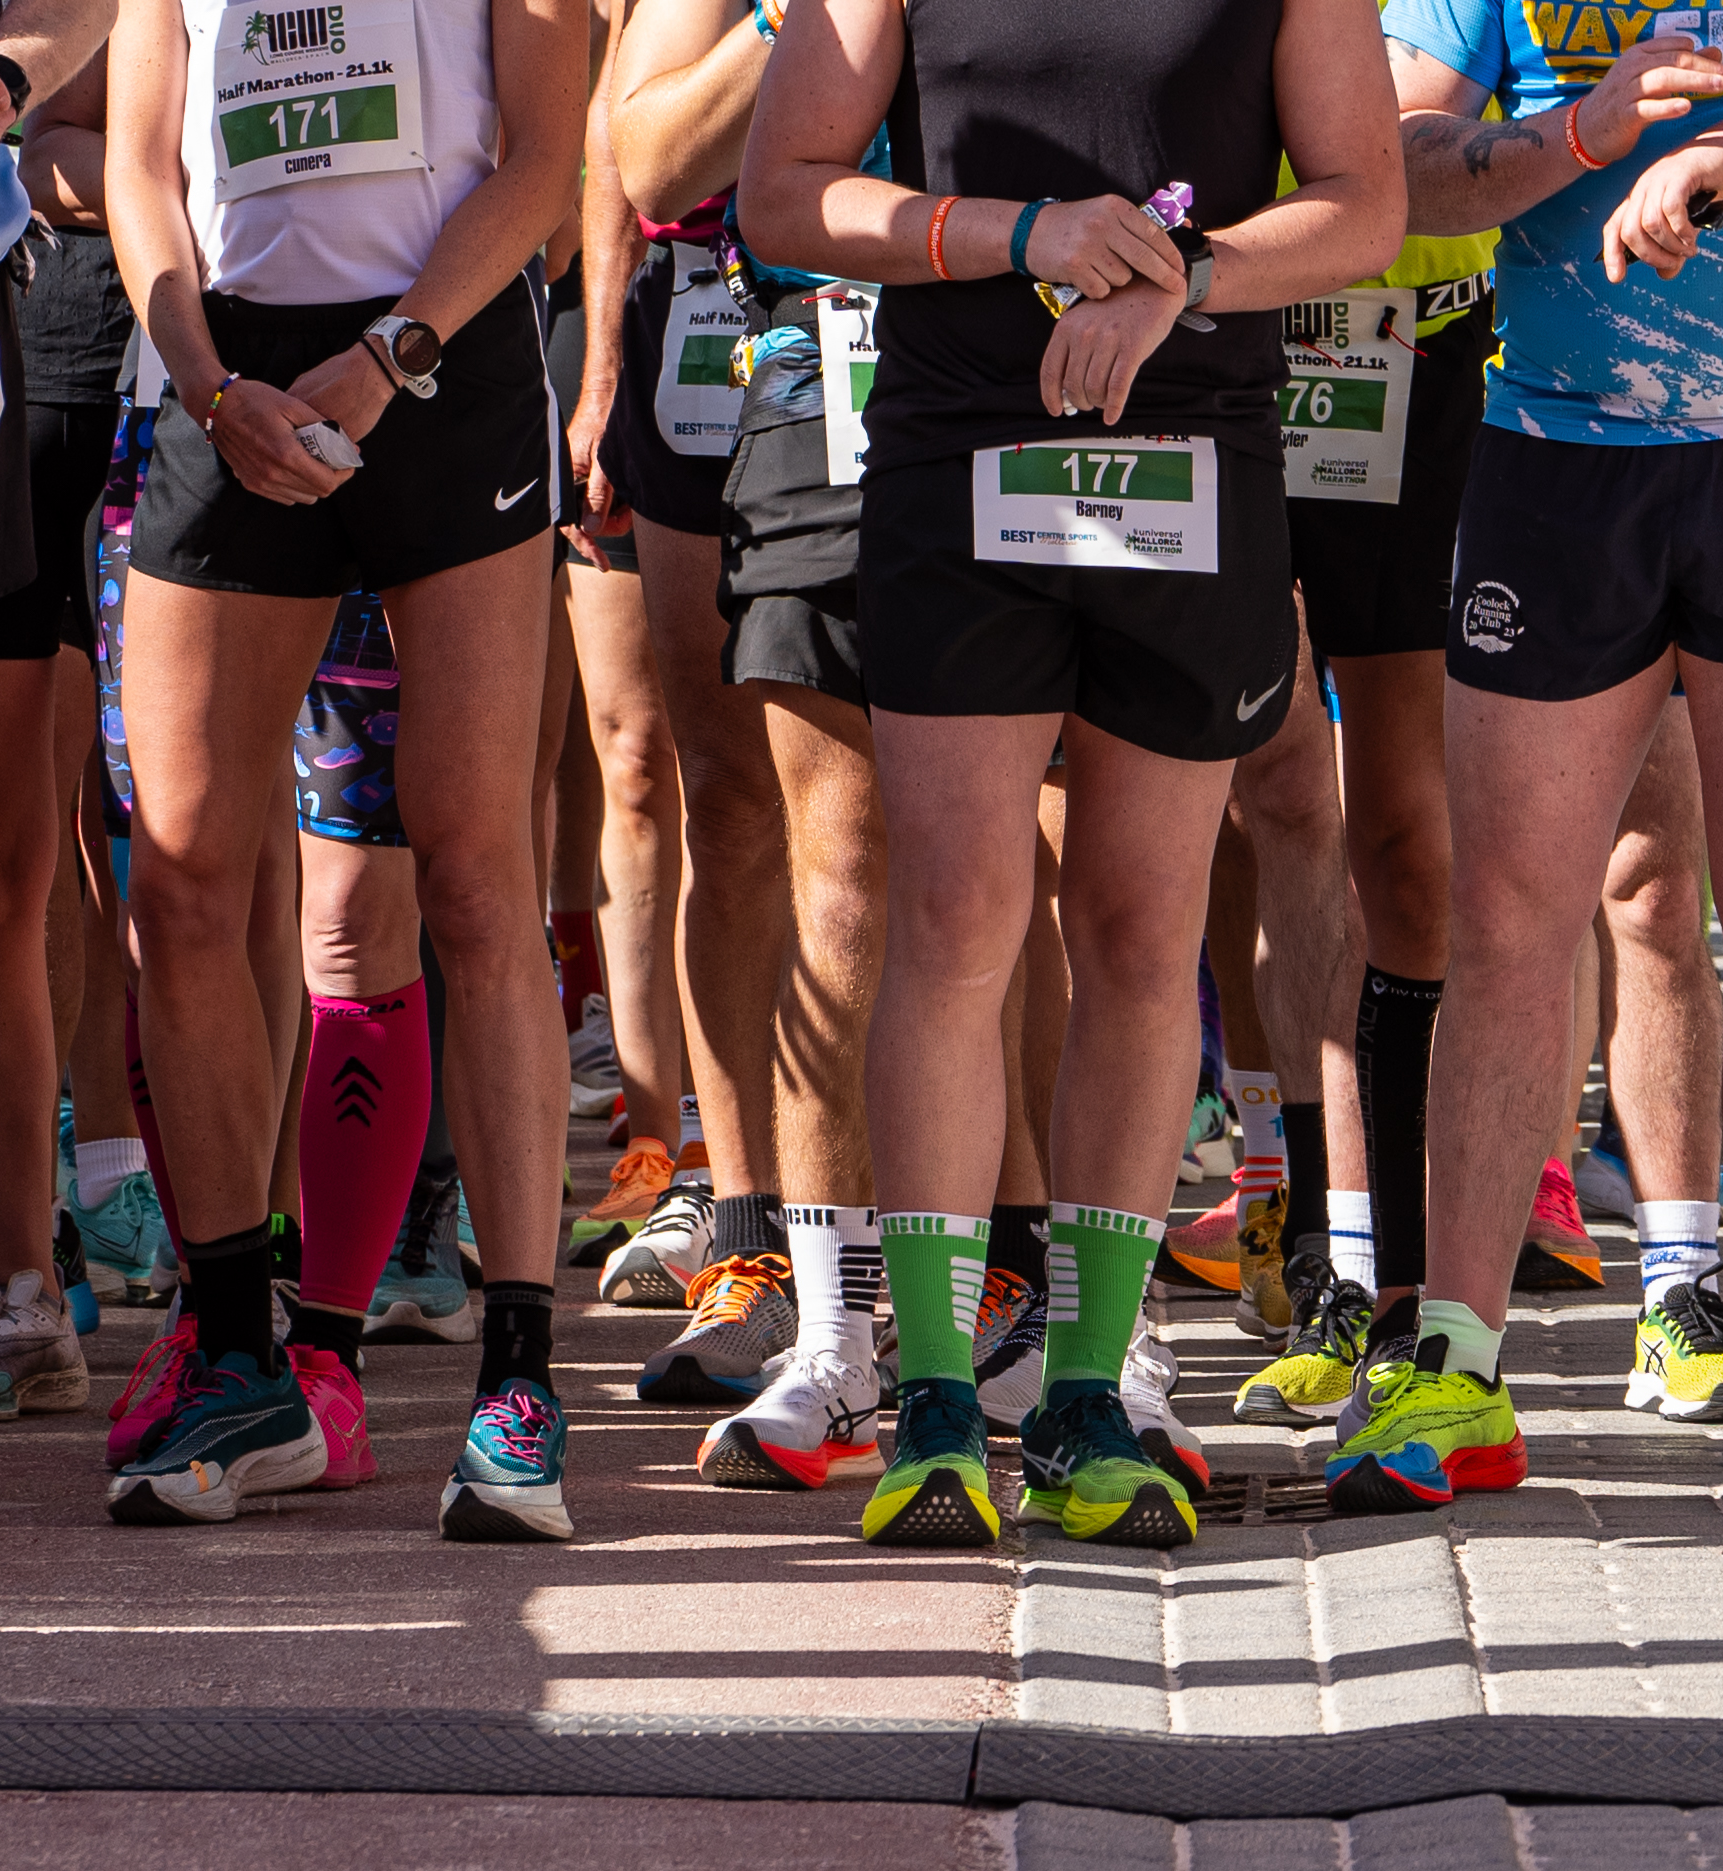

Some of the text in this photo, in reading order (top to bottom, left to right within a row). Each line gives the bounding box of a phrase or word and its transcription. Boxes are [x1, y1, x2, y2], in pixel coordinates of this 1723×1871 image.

[328, 5, 346, 54] DUO
[1522, 0, 1653, 55] WAY
[218, 82, 246, 103] Half
[247, 70, 335, 95] Marathon
[346, 60, 394, 78] 21.1k
[269, 96, 339, 148] 171
[285, 153, 332, 175] cunera
[689, 312, 717, 326] Half
[1333, 302, 1350, 349] DUO
[1344, 355, 1389, 371] 21.1k
[1275, 381, 1334, 424] 76
[674, 422, 703, 436] BEST
[1281, 430, 1309, 450] yler
[1062, 452, 1139, 494] 177
[1319, 475, 1367, 485] MARATHON
[1321, 467, 1367, 477] MALLORCA
[1076, 500, 1123, 521] Barney
[1000, 529, 1098, 543] BEST CENTRE SPORTS
[1133, 537, 1183, 546] MALLORCA
[1138, 529, 1183, 539] universal
[1133, 545, 1183, 555] MARATHON
[1476, 594, 1510, 611] Coolock
[1473, 604, 1512, 623] Running
[1468, 620, 1515, 637] 20 23
[1479, 616, 1501, 629] Club
